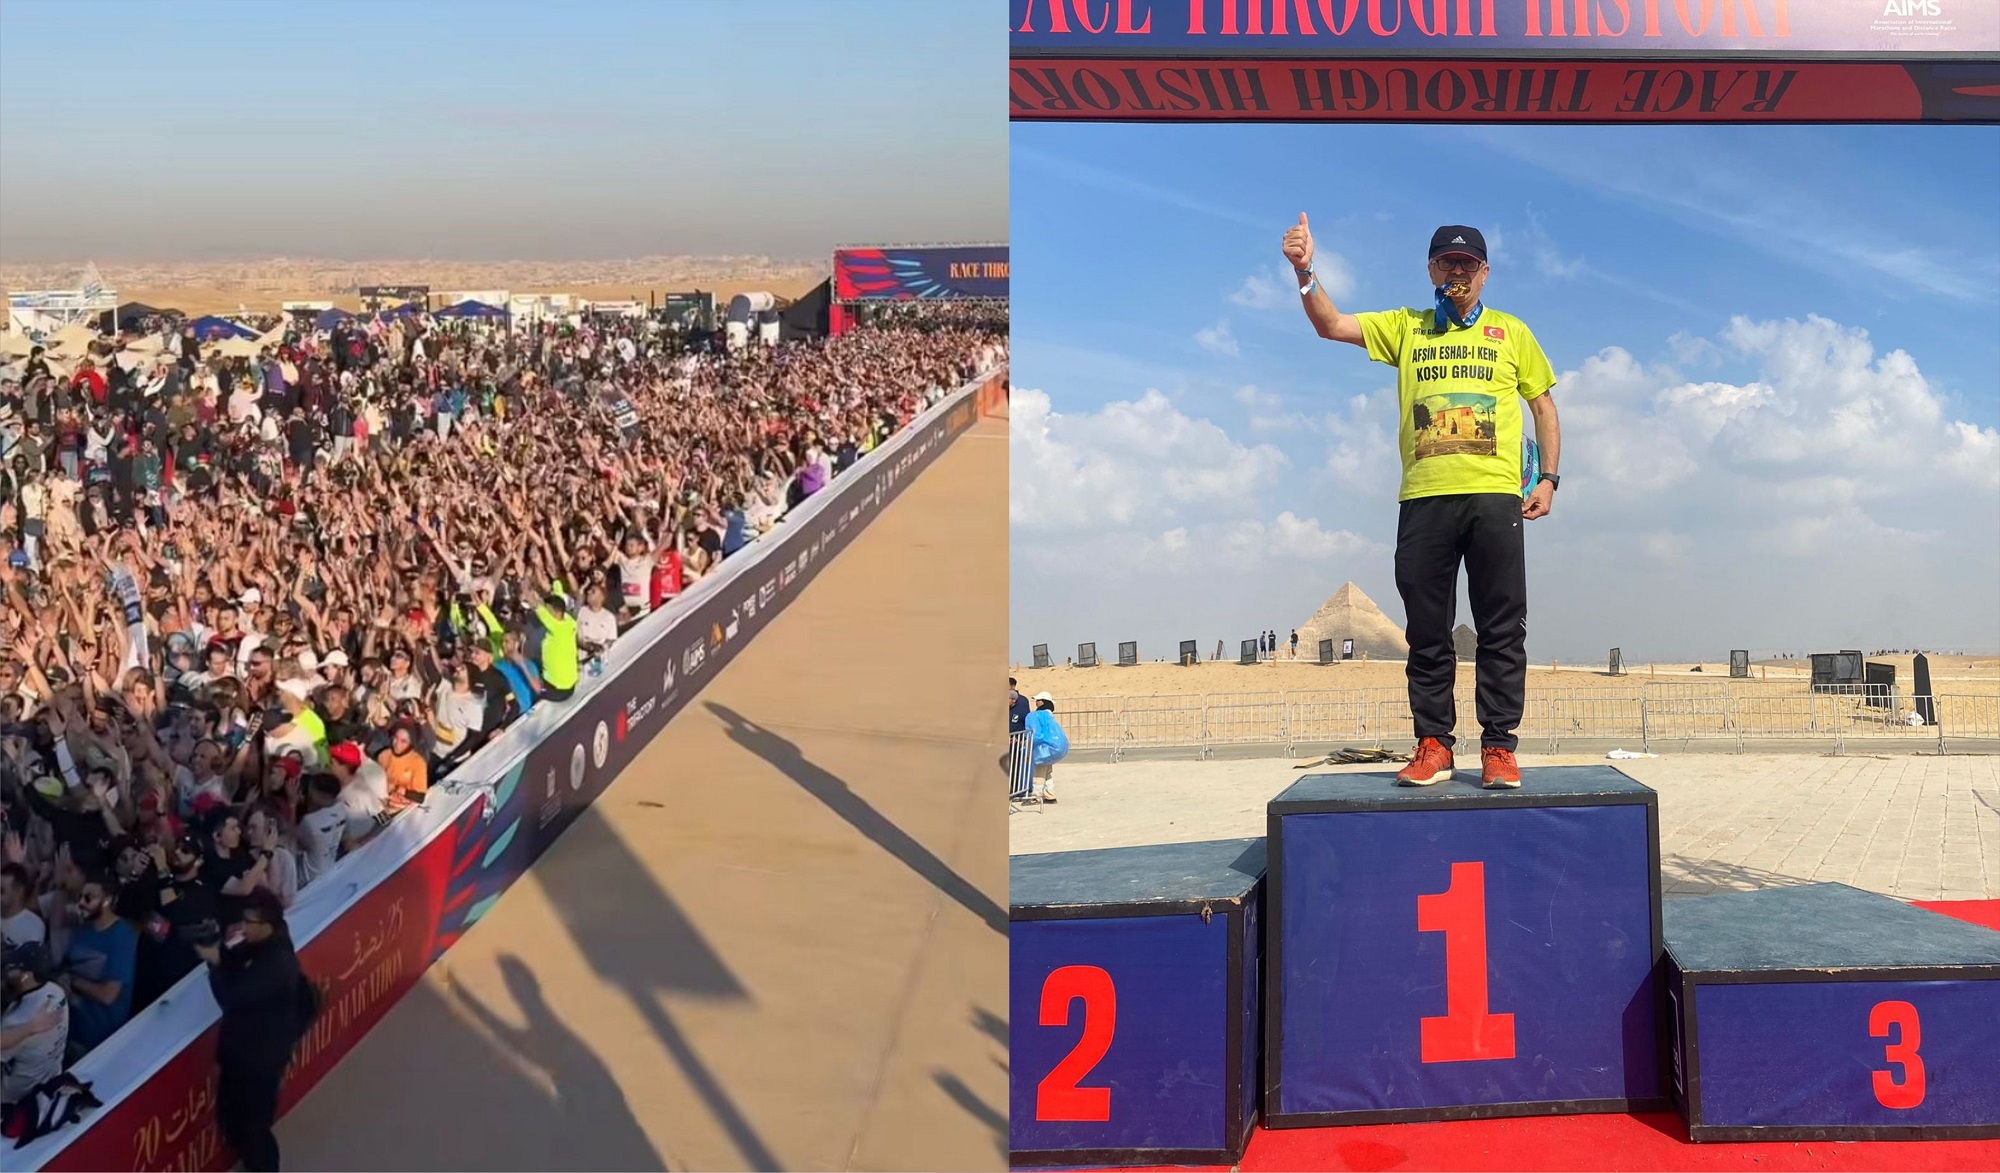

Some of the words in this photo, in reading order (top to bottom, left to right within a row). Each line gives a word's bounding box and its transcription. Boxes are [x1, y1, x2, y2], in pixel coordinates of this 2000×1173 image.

[1883, 0, 1942, 16] AIMS
[1289, 68, 1593, 112] THROUGH
[1615, 69, 1800, 113] RACE
[950, 262, 980, 279] RACE
[1412, 345, 1437, 363] AFŞİN
[1439, 346, 1475, 360] ESHAB-I
[1416, 365, 1447, 382] KOŞU
[1452, 365, 1494, 381] GRUBU
[1417, 861, 1516, 1064] 1
[1036, 965, 1117, 1122] 2
[1868, 1001, 1926, 1109] 3
